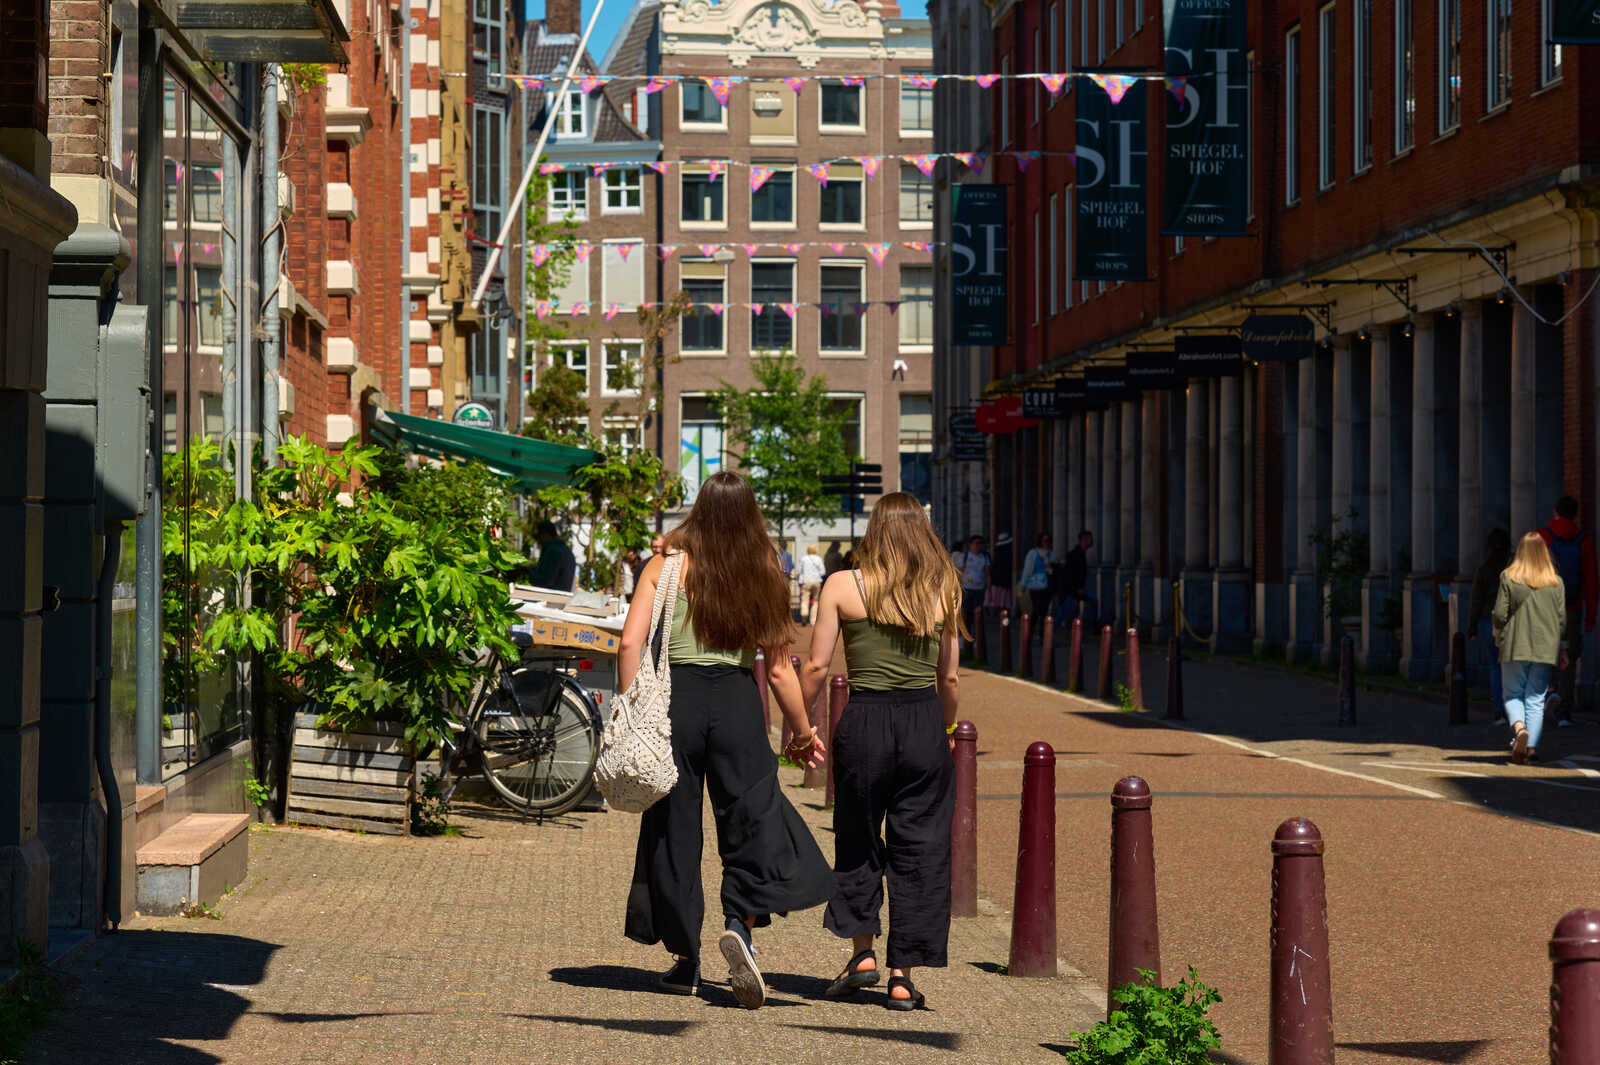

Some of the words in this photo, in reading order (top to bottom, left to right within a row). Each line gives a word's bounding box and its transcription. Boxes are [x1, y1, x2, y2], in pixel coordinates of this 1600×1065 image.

[1169, 144, 1243, 159] SPIEGEL
[1189, 160, 1225, 175] HOF
[1079, 201, 1144, 215] SPIEGEL
[1096, 215, 1129, 229] HOF
[1185, 214, 1225, 224] SHOPS
[1095, 260, 1129, 271] SHOPS
[955, 285, 1005, 296] SPIEGEL
[968, 296, 992, 307] HOF
